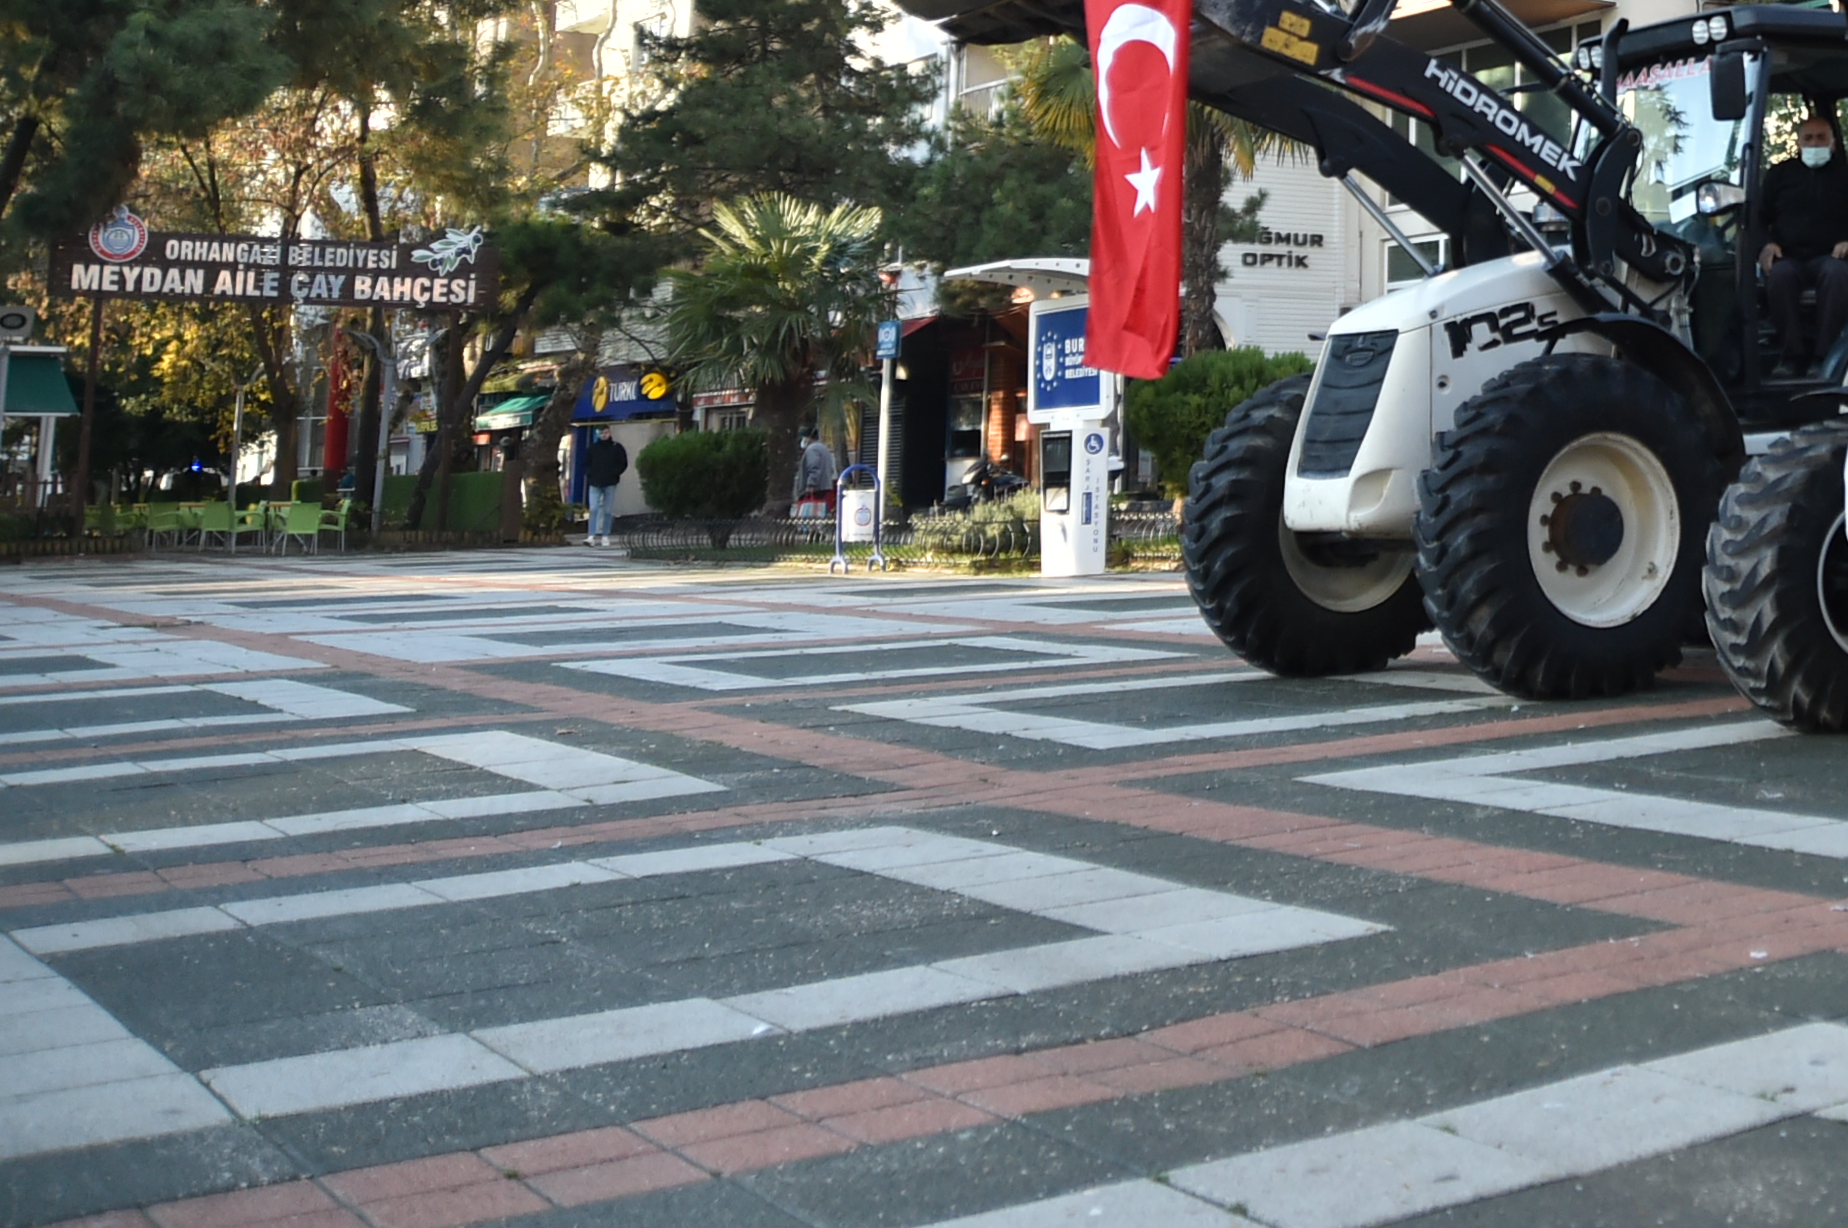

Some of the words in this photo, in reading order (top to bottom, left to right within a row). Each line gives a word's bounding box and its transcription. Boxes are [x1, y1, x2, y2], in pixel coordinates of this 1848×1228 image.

[1257, 226, 1324, 247] ĞMUR
[288, 243, 398, 270] BELEDİYESİ
[1241, 250, 1309, 268] OPTİK
[71, 263, 204, 295] MEYDAN
[213, 263, 279, 298] AİLE
[290, 272, 346, 304] ÇAY
[354, 273, 476, 309] BAHÇESİ
[1064, 337, 1085, 354] BUR
